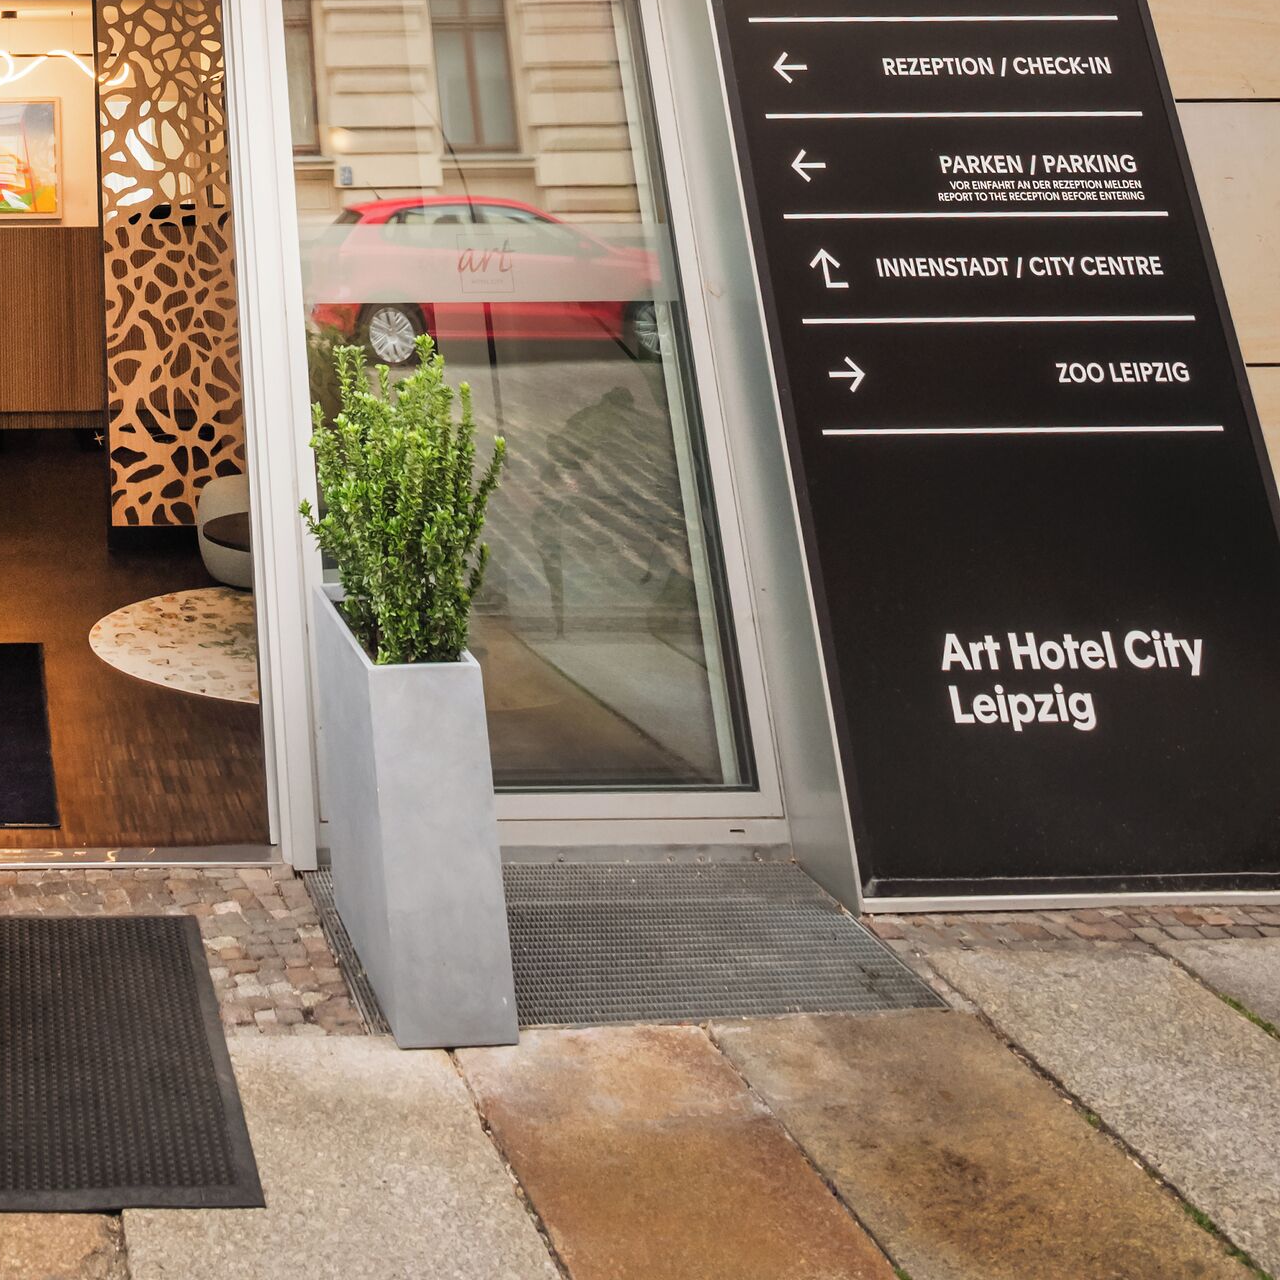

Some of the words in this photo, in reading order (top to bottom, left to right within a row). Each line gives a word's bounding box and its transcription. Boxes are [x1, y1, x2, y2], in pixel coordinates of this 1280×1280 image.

[881, 56, 995, 76] REZEPTION
[1012, 56, 1113, 75] CHECK-IN
[938, 154, 1024, 174] PARKEN
[1042, 154, 1138, 174] PARKING
[949, 180, 971, 191] VOR
[971, 180, 1016, 190] EINFAHRT
[1017, 180, 1031, 190] AN
[1031, 179, 1052, 190] DER
[1052, 179, 1103, 190] REZEPTION
[1103, 179, 1143, 189] MELDEN
[937, 191, 973, 202] REPORT
[973, 191, 988, 202] TO
[988, 191, 1008, 202] THE
[1008, 191, 1061, 202] RECEPTION
[1061, 191, 1099, 201] BEFORE
[1098, 190, 1146, 201] ENTERING
[875, 256, 1009, 278] INNENSTADT
[1029, 256, 1075, 276] CITY
[1080, 255, 1164, 276] CENTRE
[1055, 362, 1105, 384] ZOO
[1108, 361, 1191, 383] LEIPZIG
[941, 632, 1001, 671] Art
[1007, 630, 1118, 670] Hotel
[1123, 629, 1203, 677] City
[948, 683, 1097, 732] Leipzig
